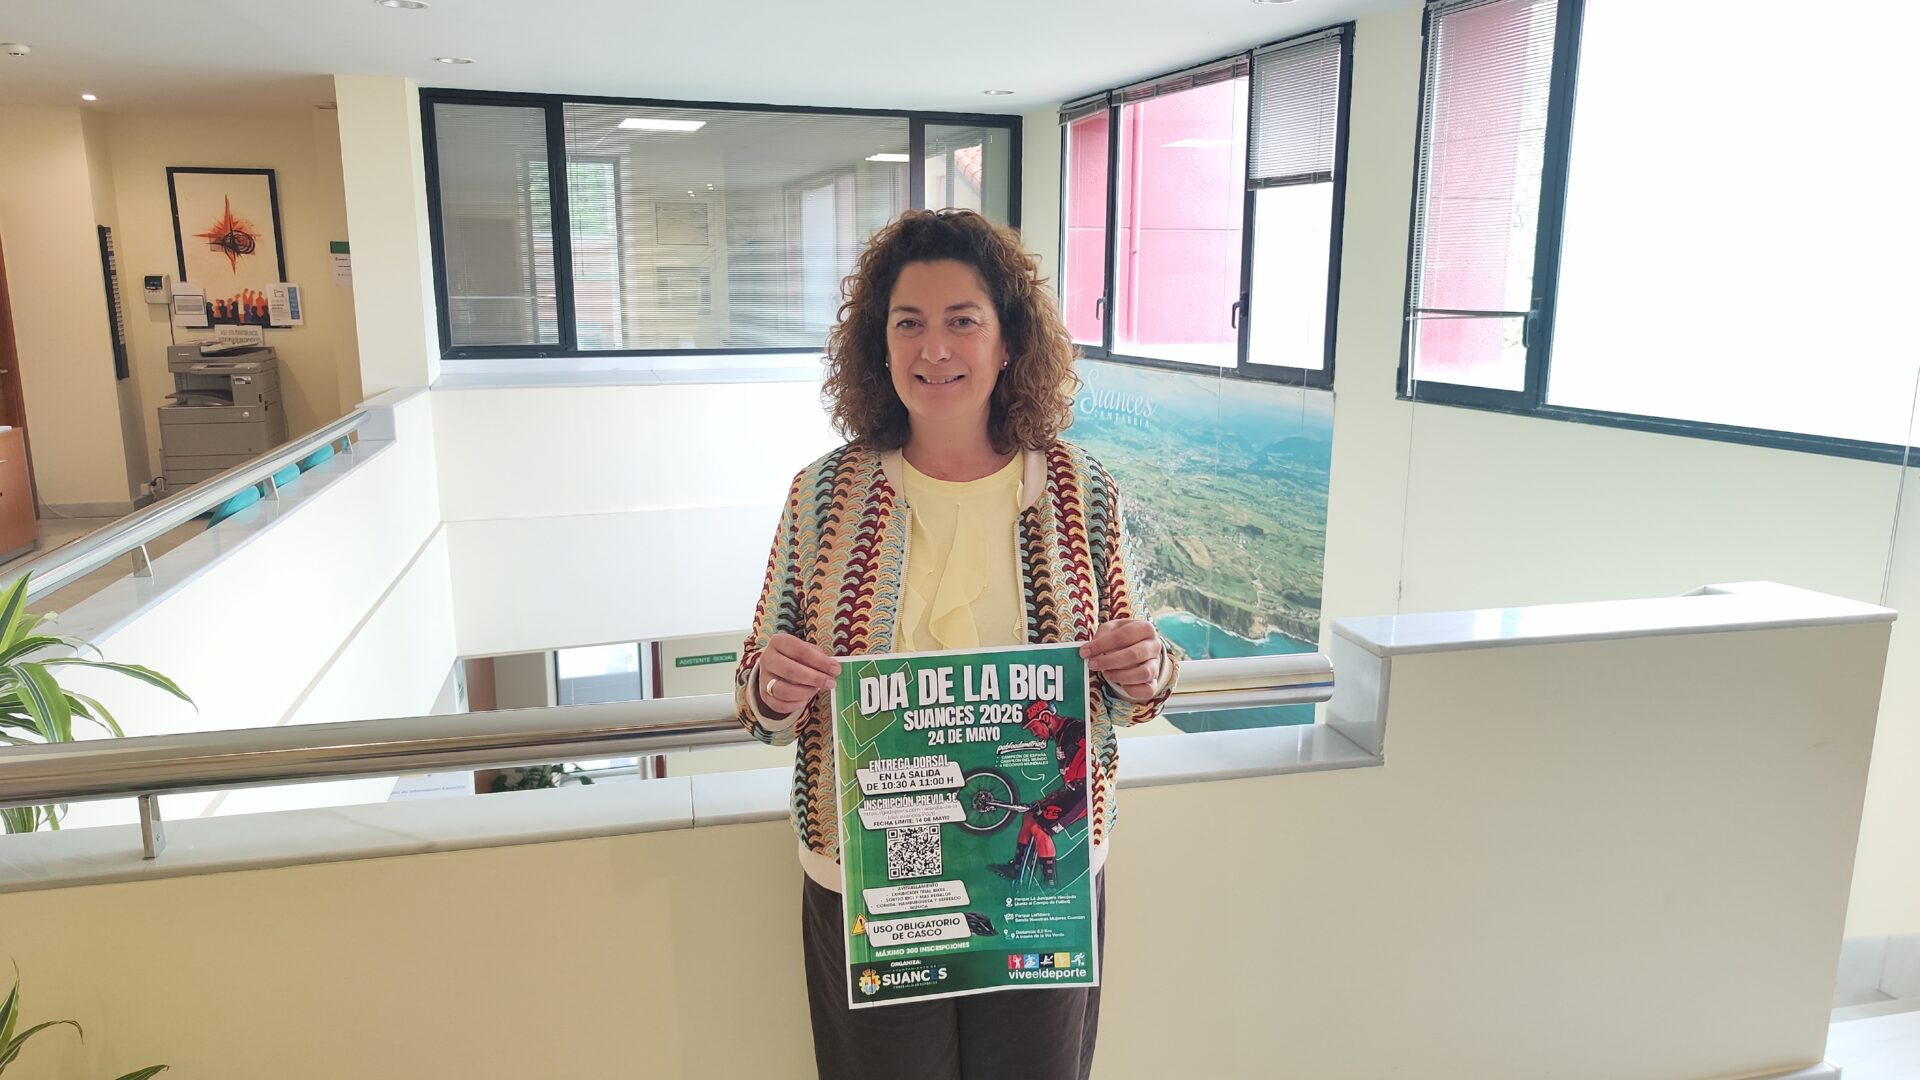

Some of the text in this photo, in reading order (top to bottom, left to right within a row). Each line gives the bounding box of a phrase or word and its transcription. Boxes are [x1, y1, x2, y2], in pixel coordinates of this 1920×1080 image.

[1080, 368, 1157, 417] Suances
[918, 667, 954, 706] DE
[963, 664, 1000, 701] LA
[1009, 664, 1063, 701] BICI
[904, 706, 974, 731] SUANCES
[980, 704, 1023, 724] 2026
[928, 727, 1000, 746] 24 DE MAYO
[869, 754, 949, 773] ENTREGA DORSAL
[909, 769, 940, 778] SALIDA
[867, 783, 878, 791] DE
[882, 781, 907, 789] 10:30
[920, 777, 945, 786] 11:00
[864, 792, 958, 811] INSCRIPCIÓN PREVIA 3€
[873, 918, 960, 934] USO OBLIGATORIO
[892, 929, 942, 940] DE CASCO
[876, 946, 904, 958] MÁXIMO
[920, 942, 970, 953] INSCRIPCIONES
[891, 960, 921, 968] ORGANIZA:
[882, 967, 948, 986] SUANCES
[1009, 968, 1086, 980] viveeldeporte
